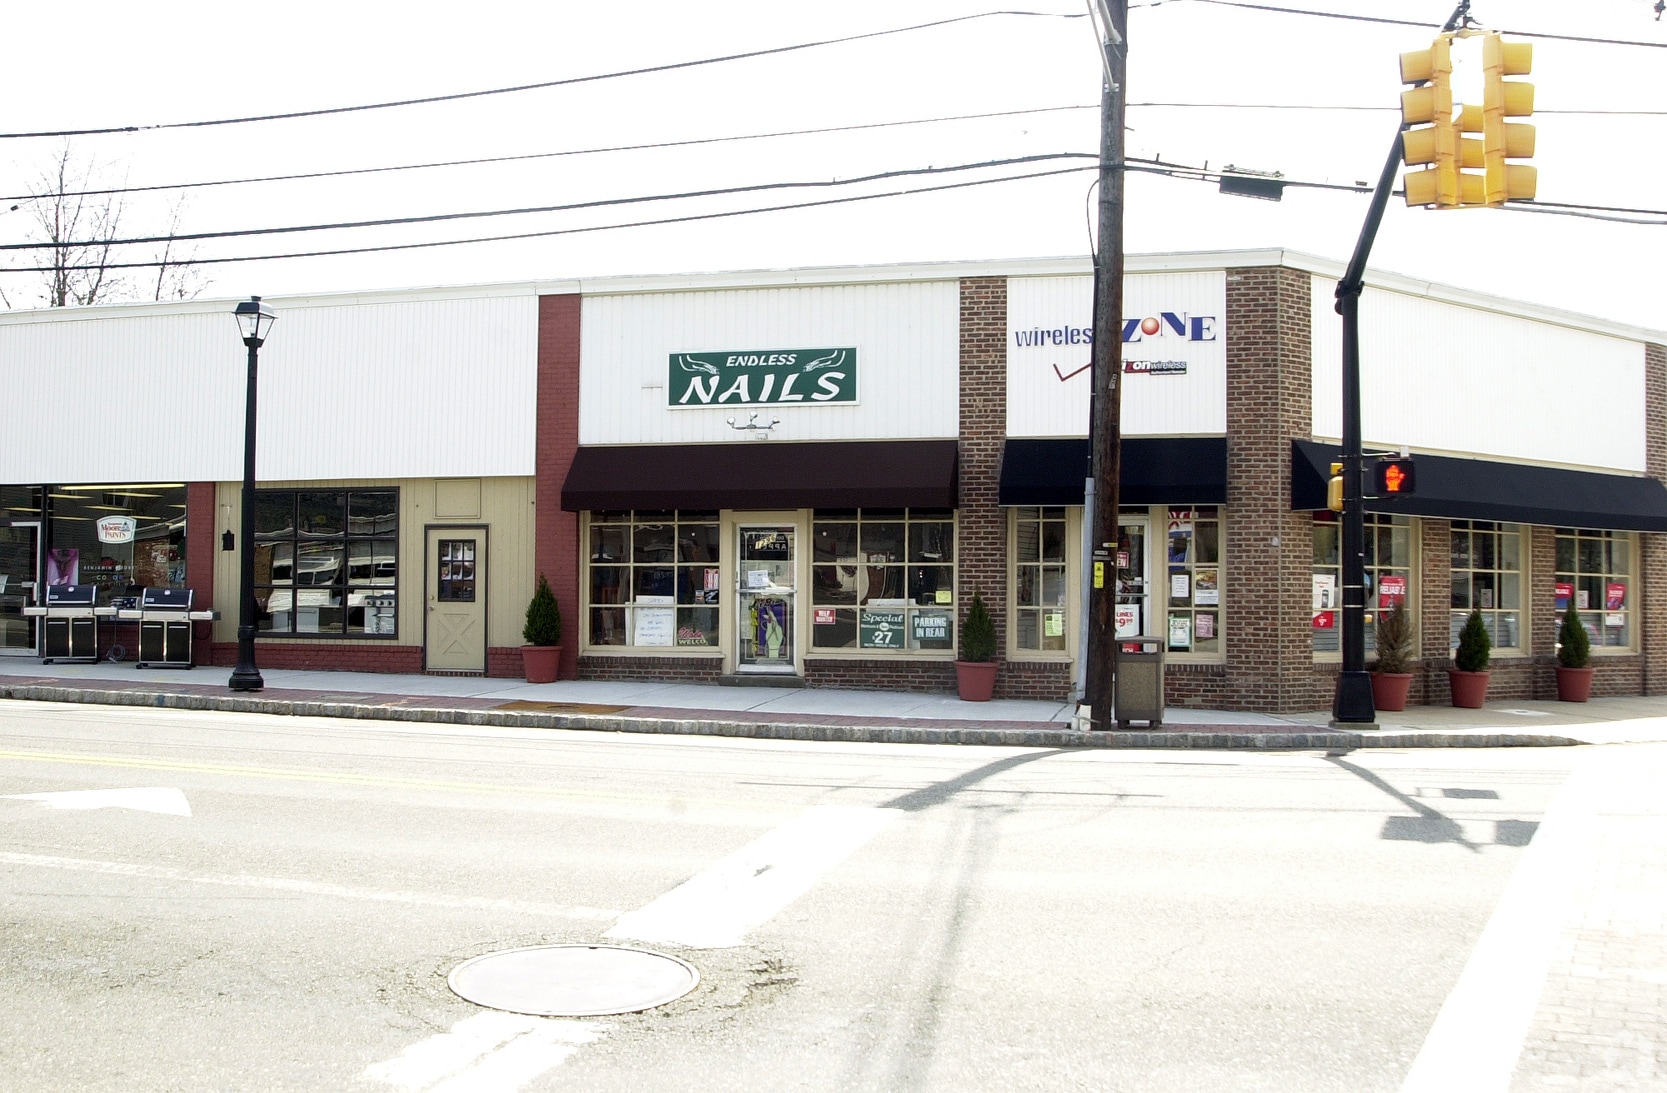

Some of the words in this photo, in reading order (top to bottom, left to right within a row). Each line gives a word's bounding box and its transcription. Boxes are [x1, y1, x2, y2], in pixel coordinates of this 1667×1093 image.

[1015, 325, 1093, 347] wireles
[1121, 311, 1216, 343] ZONE
[726, 354, 798, 367] ENDLESS
[1121, 358, 1150, 371] izon
[679, 371, 846, 404] NAILS
[861, 613, 904, 624] Special
[914, 617, 947, 627] PARKING
[916, 628, 924, 637] IN
[925, 628, 945, 637] REAR
